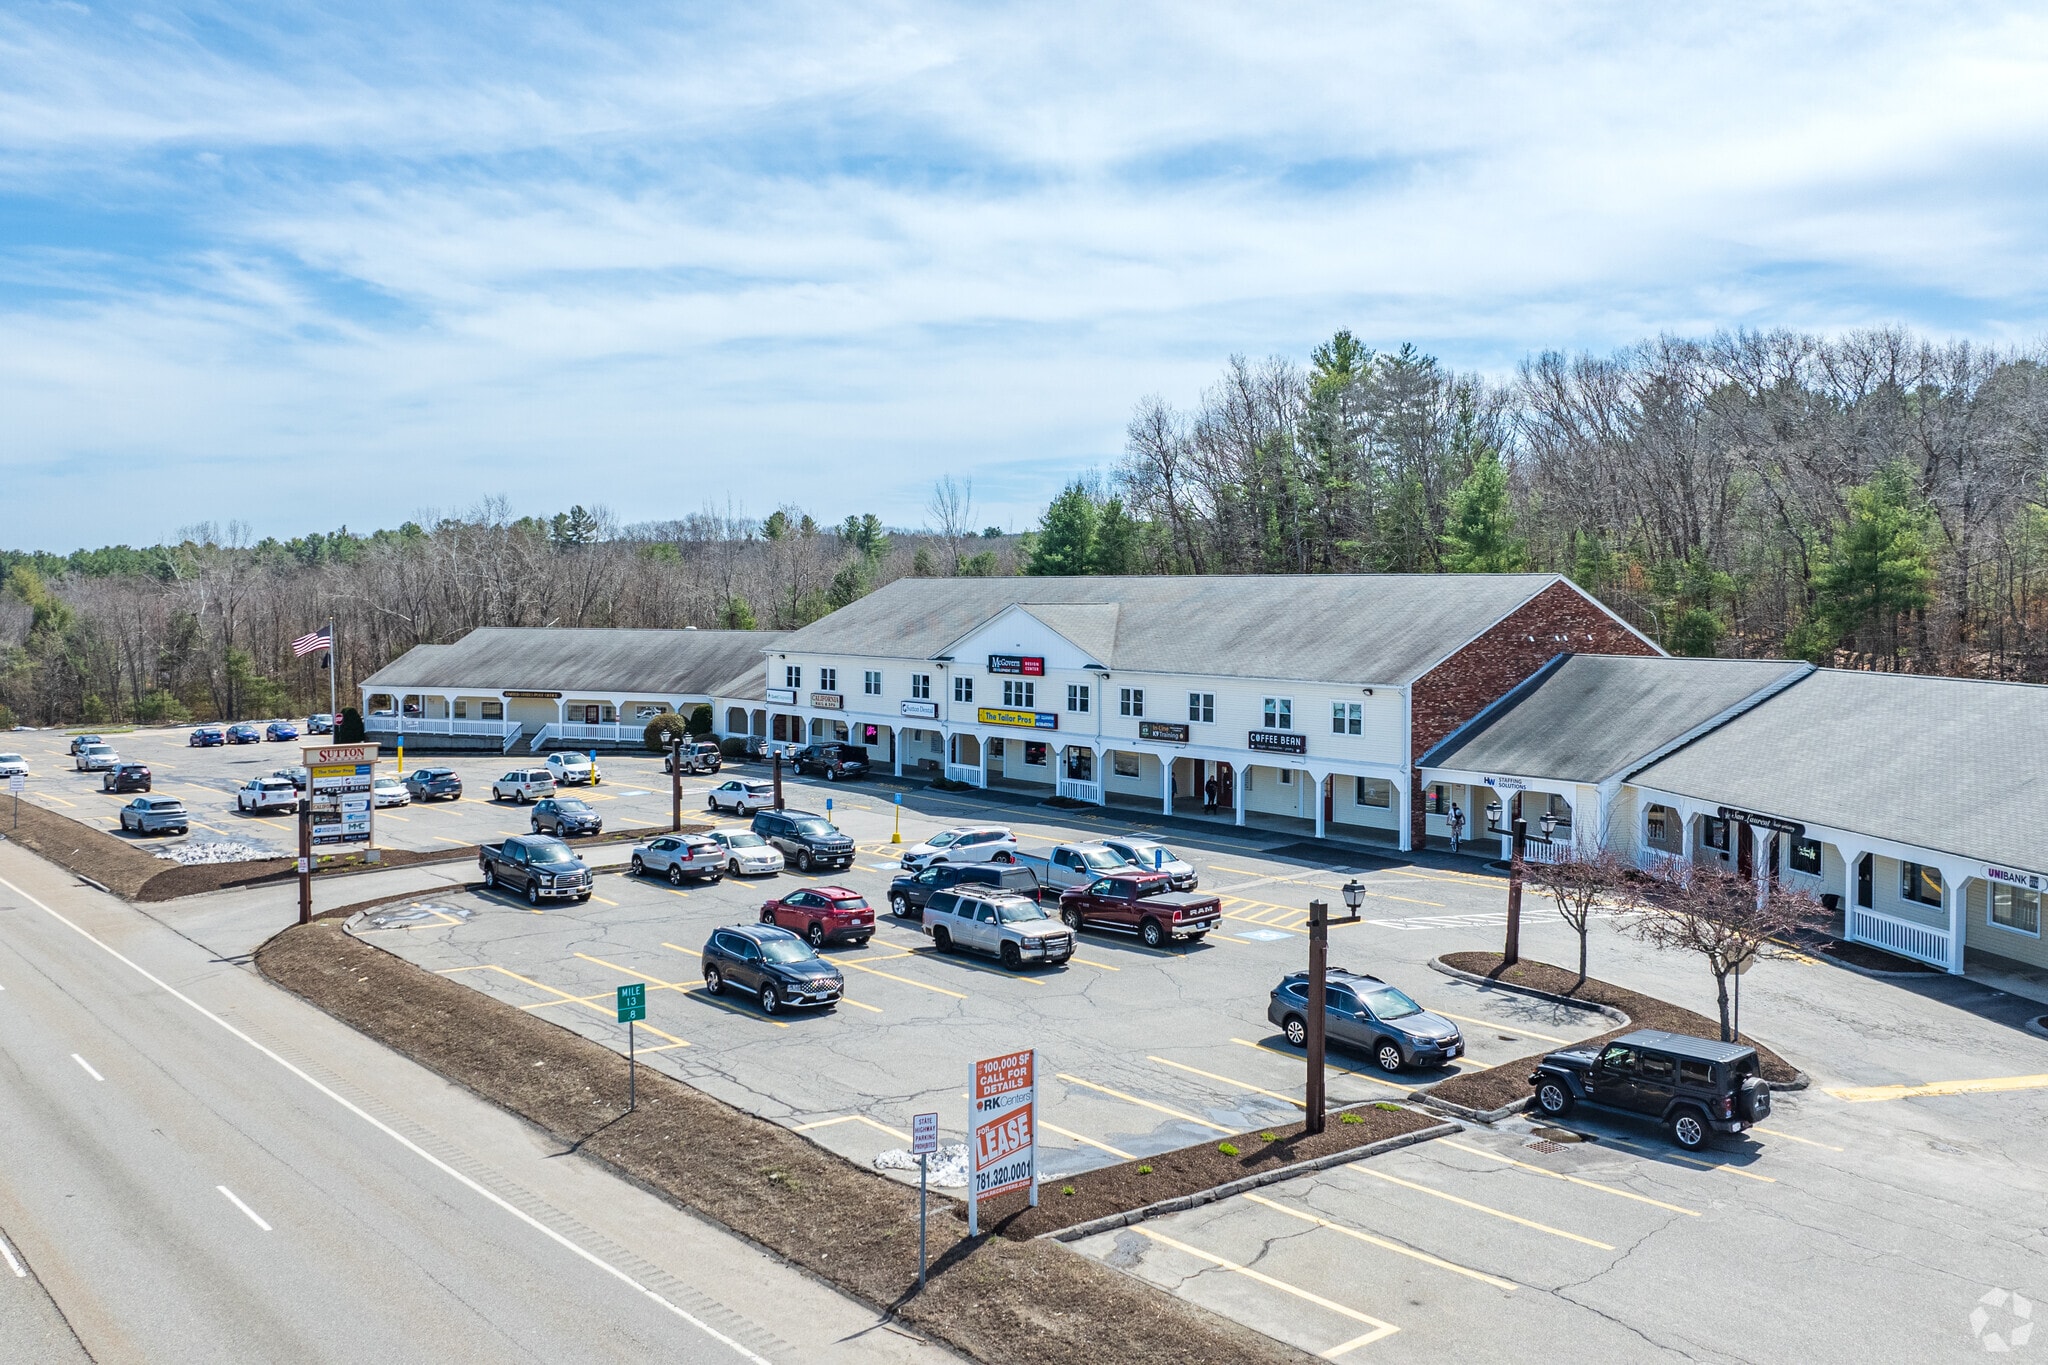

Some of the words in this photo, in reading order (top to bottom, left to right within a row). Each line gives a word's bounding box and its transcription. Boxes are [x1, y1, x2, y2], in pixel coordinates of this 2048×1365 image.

[992, 656, 1020, 668] McGovern
[906, 704, 919, 713] Sutton
[919, 705, 934, 714] Dental
[986, 712, 996, 721] The
[998, 713, 1016, 722] Tailor
[1017, 715, 1032, 724] Pros
[1250, 733, 1278, 744] COFFEE
[1280, 736, 1301, 746] BEAN
[319, 748, 364, 762] SUTTON
[1483, 776, 1495, 786] HW
[1731, 811, 1744, 821] San
[1988, 868, 2027, 885] UNIBANK
[1190, 906, 1213, 916] RAM
[622, 986, 640, 997] MILE
[626, 997, 637, 1006] 13
[984, 1055, 1017, 1074] 100,000
[1018, 1053, 1030, 1066] SF
[980, 1072, 1005, 1085] CALL
[1008, 1067, 1027, 1080] FOR
[984, 1078, 1024, 1095] DETAILS
[984, 1091, 1031, 1112] RKCenters
[978, 1126, 990, 1137] FOR
[976, 1114, 1031, 1165] LEASE
[915, 1142, 935, 1150] PROHIBITED
[976, 1160, 1031, 1191] 781.320.0001
